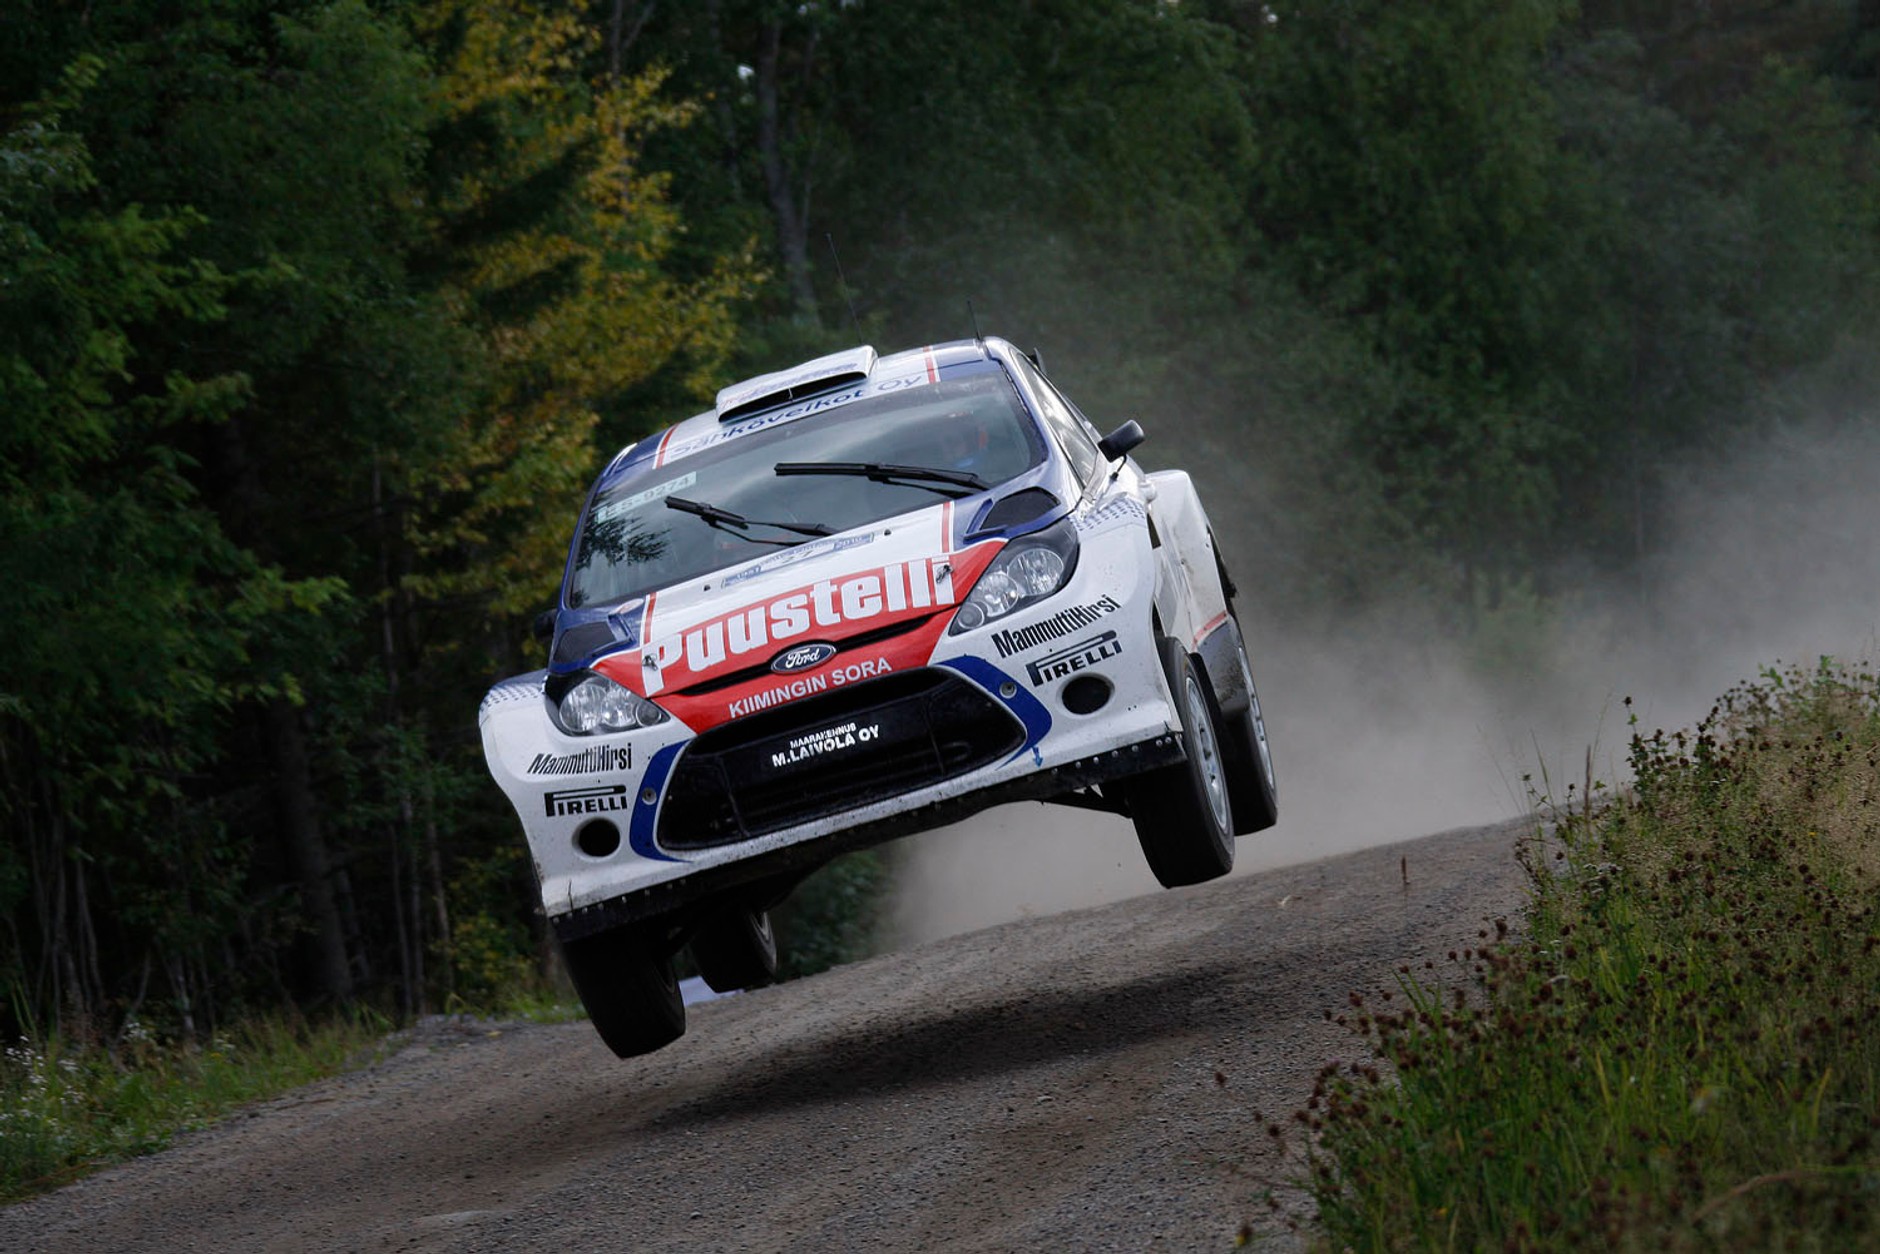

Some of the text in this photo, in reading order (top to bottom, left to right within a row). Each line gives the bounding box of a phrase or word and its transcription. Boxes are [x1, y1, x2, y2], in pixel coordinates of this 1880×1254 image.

[877, 373, 923, 393] Oy
[641, 556, 955, 698] Puustelli
[991, 594, 1122, 659] MammuttiHirsi
[785, 645, 821, 668] Ford
[1025, 630, 1123, 687] PIRELLI
[728, 656, 892, 719] KIIMINGIN SORA
[858, 724, 880, 742] OY
[527, 742, 632, 776] MammuttiHirsi
[543, 784, 628, 817] PIRELLI
